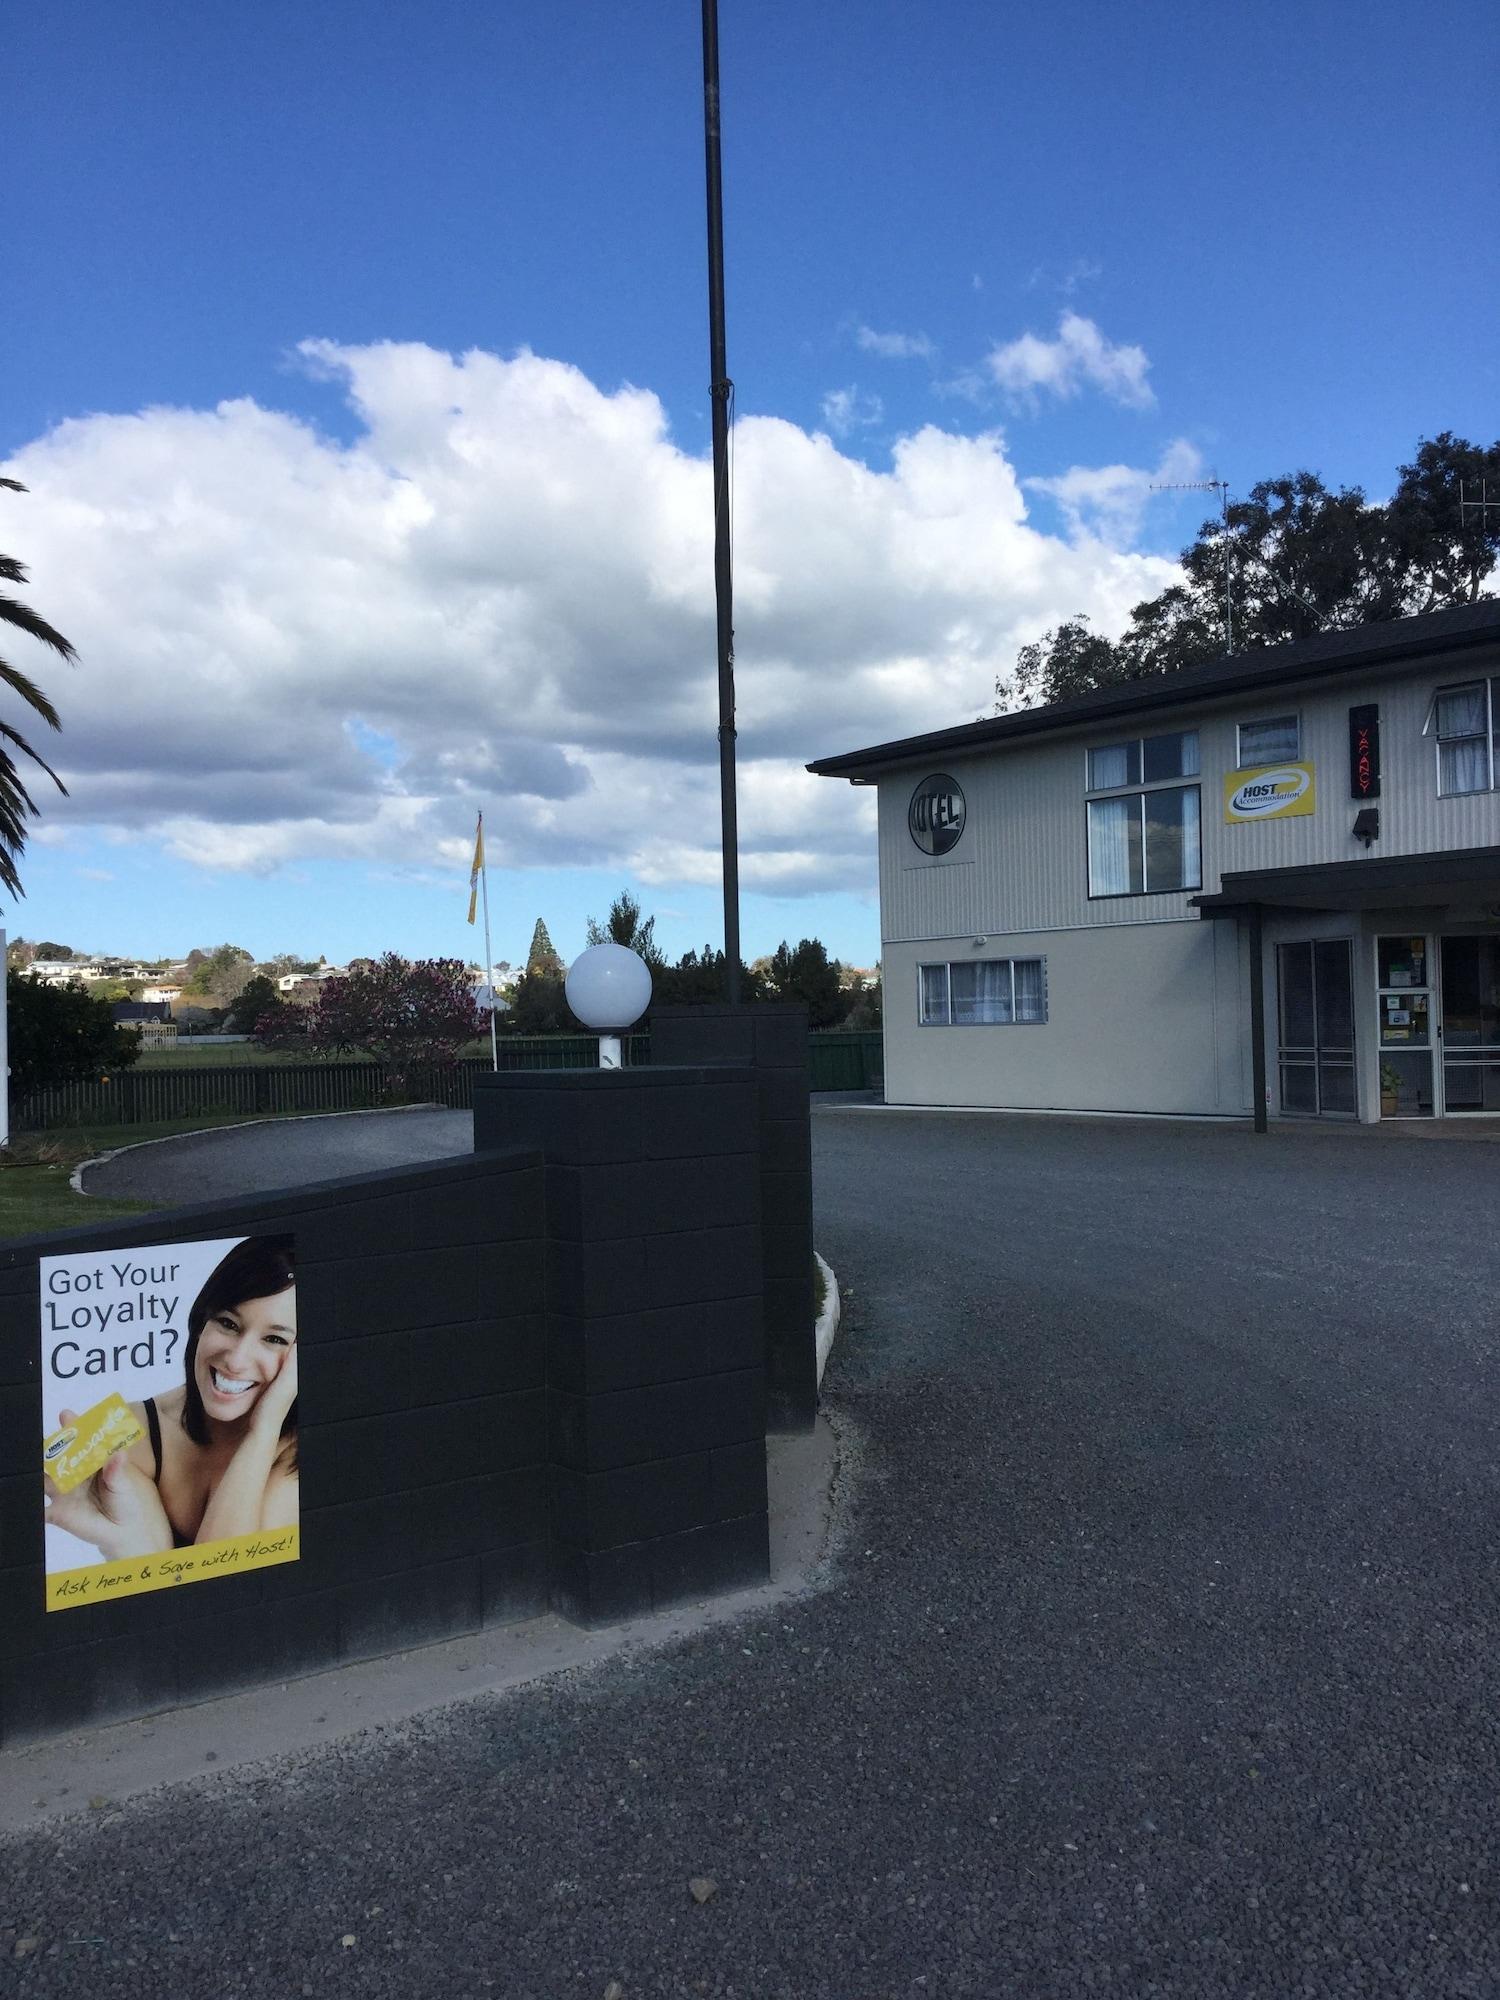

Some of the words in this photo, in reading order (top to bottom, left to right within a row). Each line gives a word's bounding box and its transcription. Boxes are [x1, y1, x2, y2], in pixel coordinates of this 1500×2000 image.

[1359, 728, 1370, 793] VACANCY
[1239, 791, 1299, 805] Accommodation
[1243, 783, 1278, 798] HOST
[48, 1267, 104, 1295] Got
[110, 1262, 180, 1288] Your
[50, 1292, 179, 1332] Loyalty
[51, 1328, 179, 1379] Card?
[48, 1439, 65, 1453] HOST
[56, 1576, 90, 1597] Ask
[96, 1574, 132, 1589] here
[140, 1565, 151, 1580] &
[159, 1560, 194, 1576] Save
[201, 1548, 239, 1567] with
[245, 1535, 294, 1559] Host!
